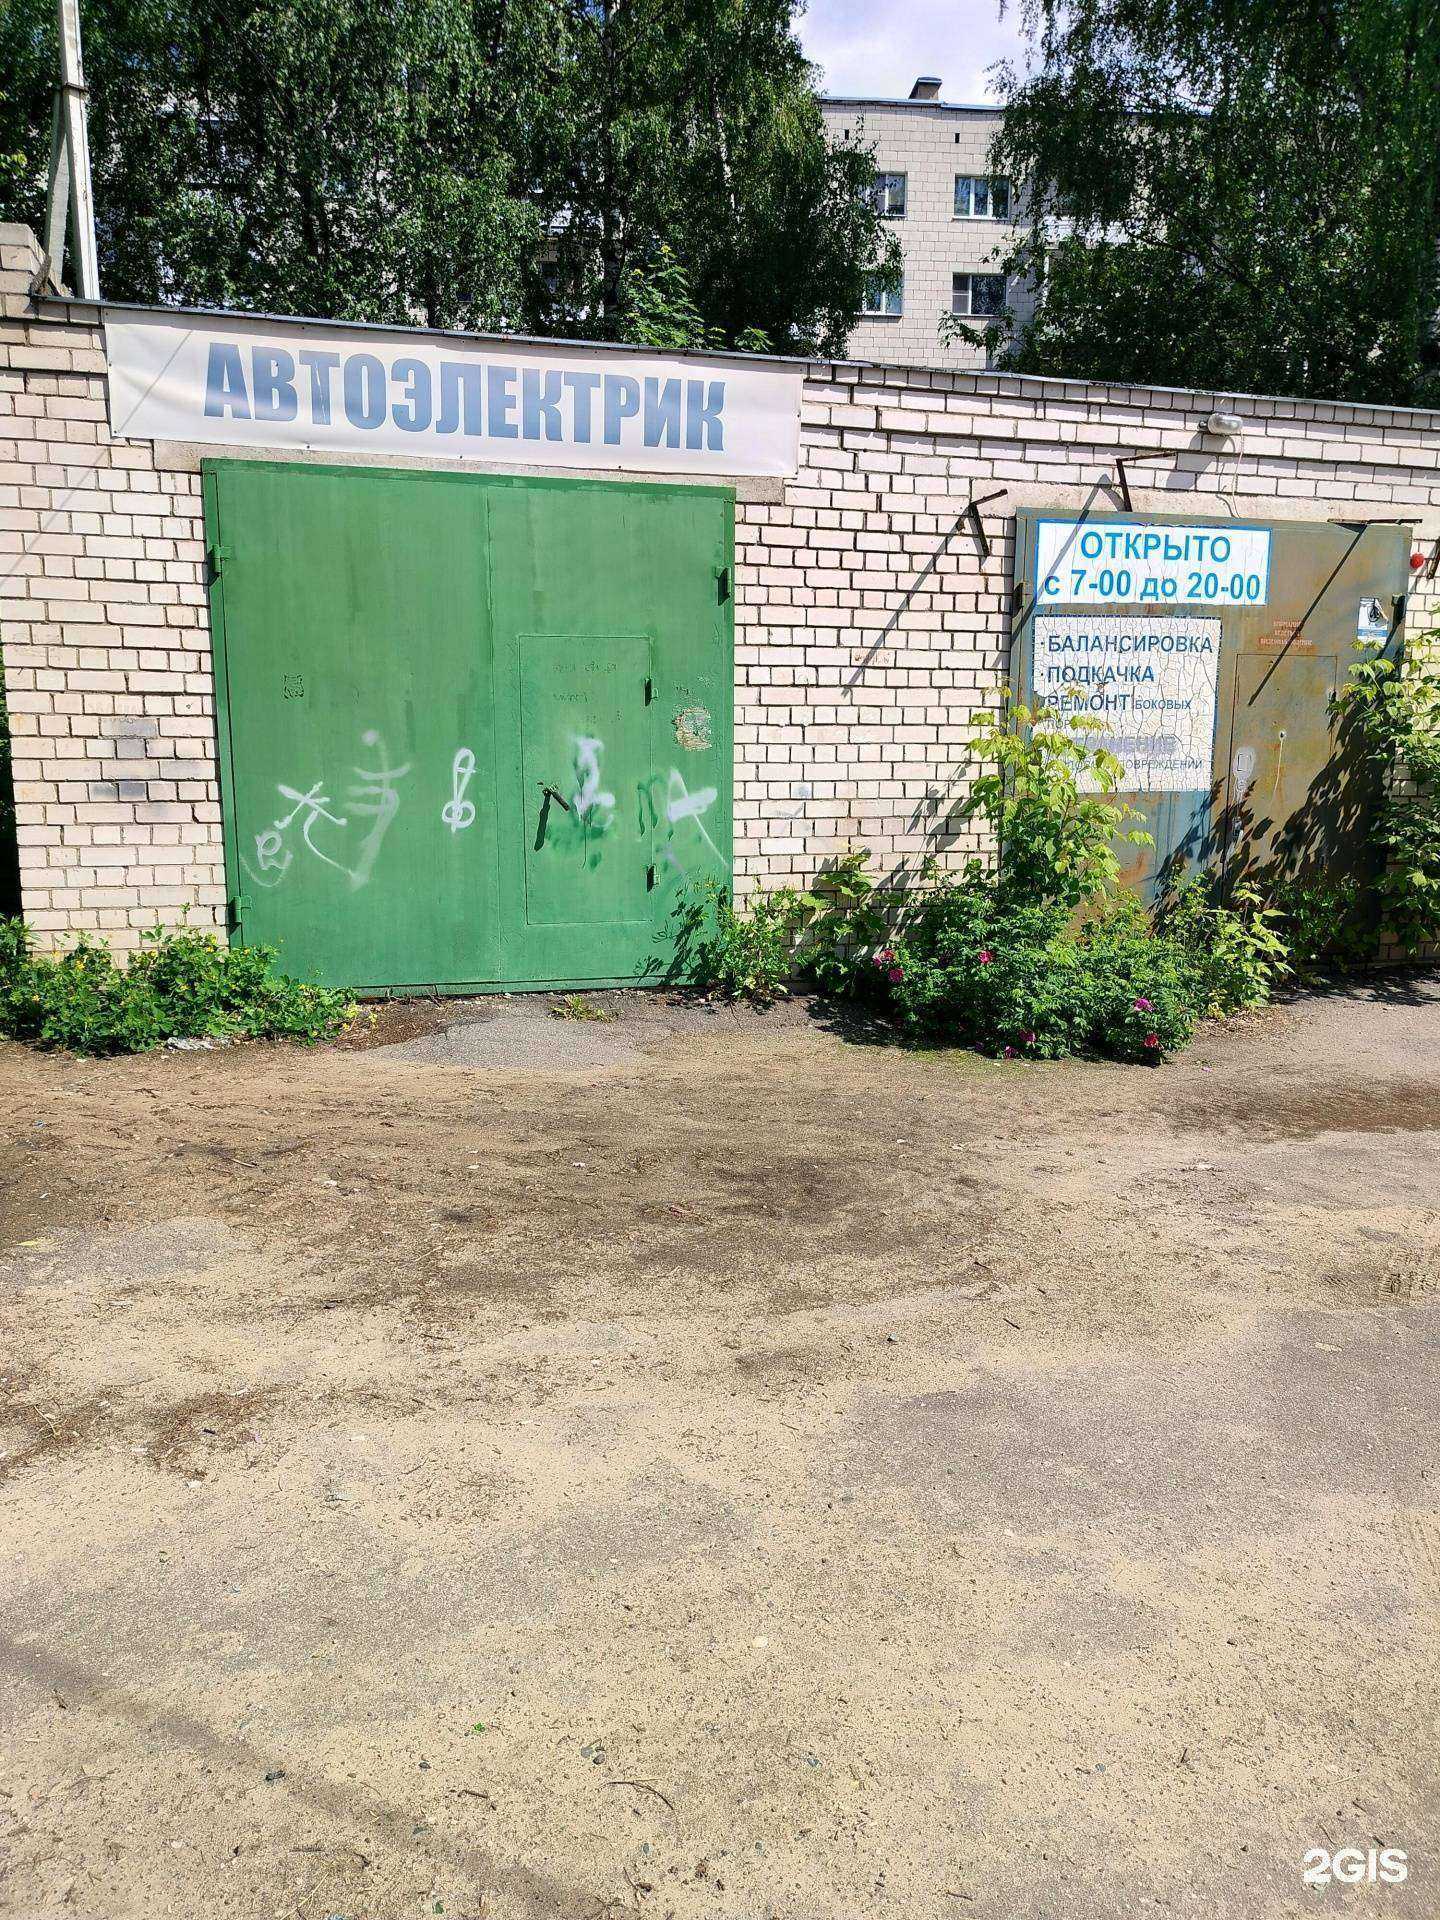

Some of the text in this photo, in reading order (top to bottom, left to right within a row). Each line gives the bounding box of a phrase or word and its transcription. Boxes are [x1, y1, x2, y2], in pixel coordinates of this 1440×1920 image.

[203, 342, 726, 452] АВТОЭЛЕКТРИК
[1080, 530, 1231, 563] ОТКРЫТО
[1071, 568, 1131, 597] 7-00
[1140, 576, 1177, 601] до
[1187, 571, 1260, 600] 20-00
[1048, 634, 1213, 653] БАЛАНСИРОВКА
[1048, 665, 1155, 686] ПОДКАЧКА
[1047, 693, 1192, 711] РЕМОНТ БОКОВЫХ
